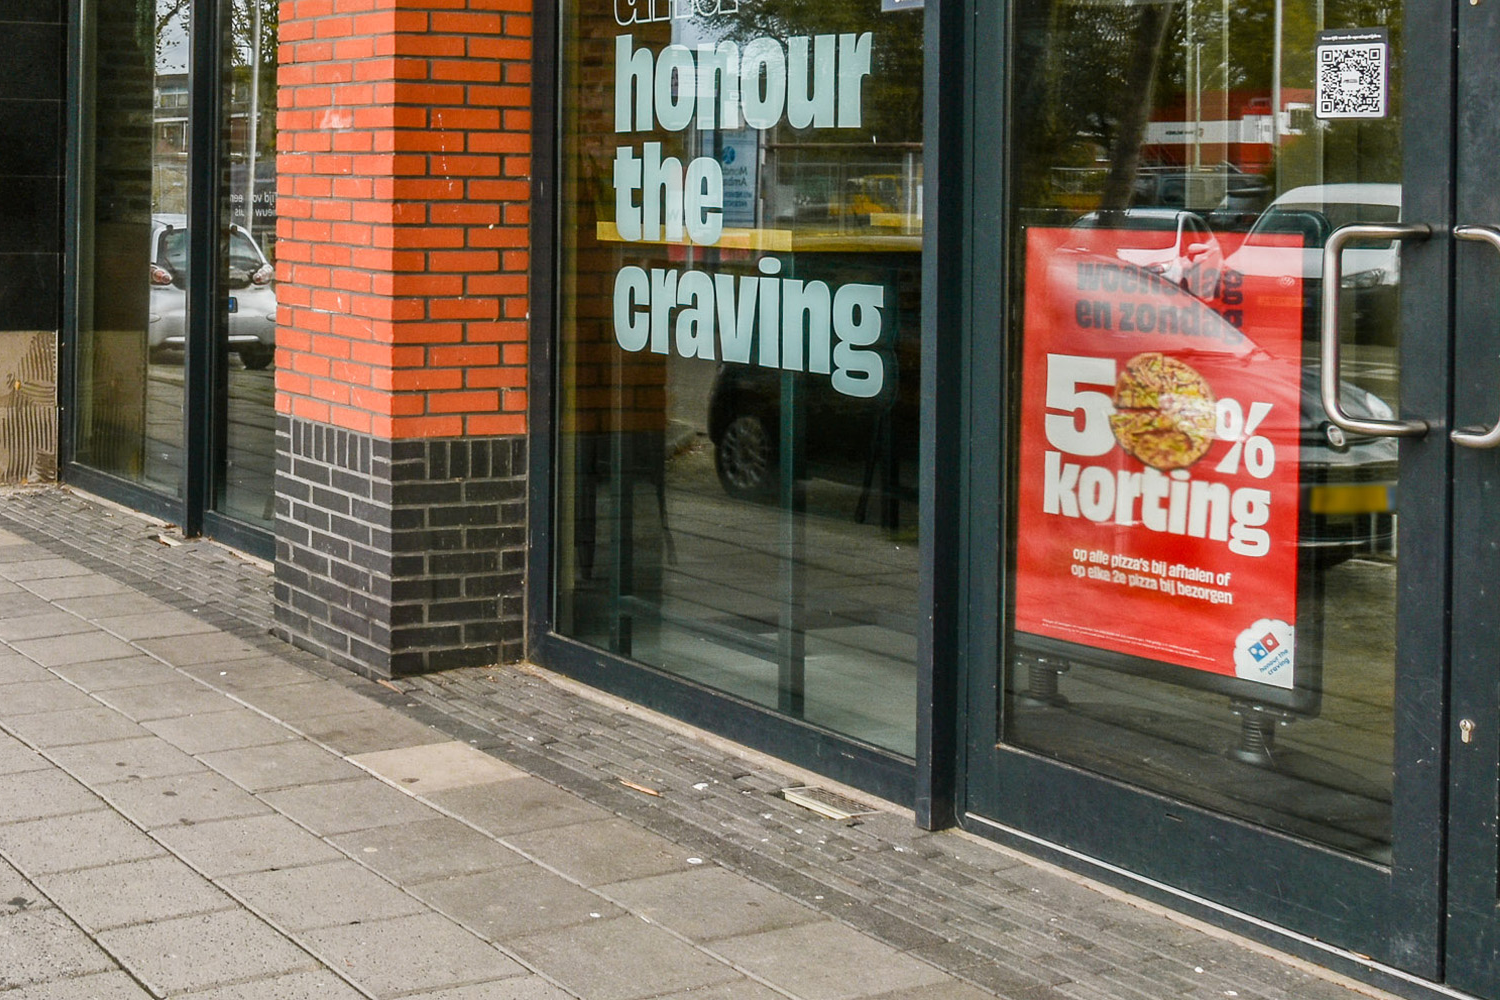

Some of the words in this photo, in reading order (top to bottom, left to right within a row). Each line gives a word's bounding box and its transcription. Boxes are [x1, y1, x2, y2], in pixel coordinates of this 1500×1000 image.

[614, 31, 873, 133] honour
[613, 141, 724, 246] the
[613, 256, 885, 398] craving
[1075, 299, 1112, 330] en
[1118, 301, 1244, 345] zondag
[1043, 450, 1271, 558] korting
[1071, 564, 1086, 578] op
[1087, 566, 1111, 582] elke
[1112, 569, 1126, 585] 2e
[1128, 573, 1158, 591] pizza
[1159, 578, 1176, 596] bij
[1177, 581, 1233, 605] bezorgen
[1072, 548, 1087, 562] op
[1089, 550, 1109, 565] alle
[1111, 554, 1150, 573] pizza's
[1151, 560, 1167, 577] bij
[1169, 563, 1214, 584] afhalen
[1216, 572, 1231, 587] of
